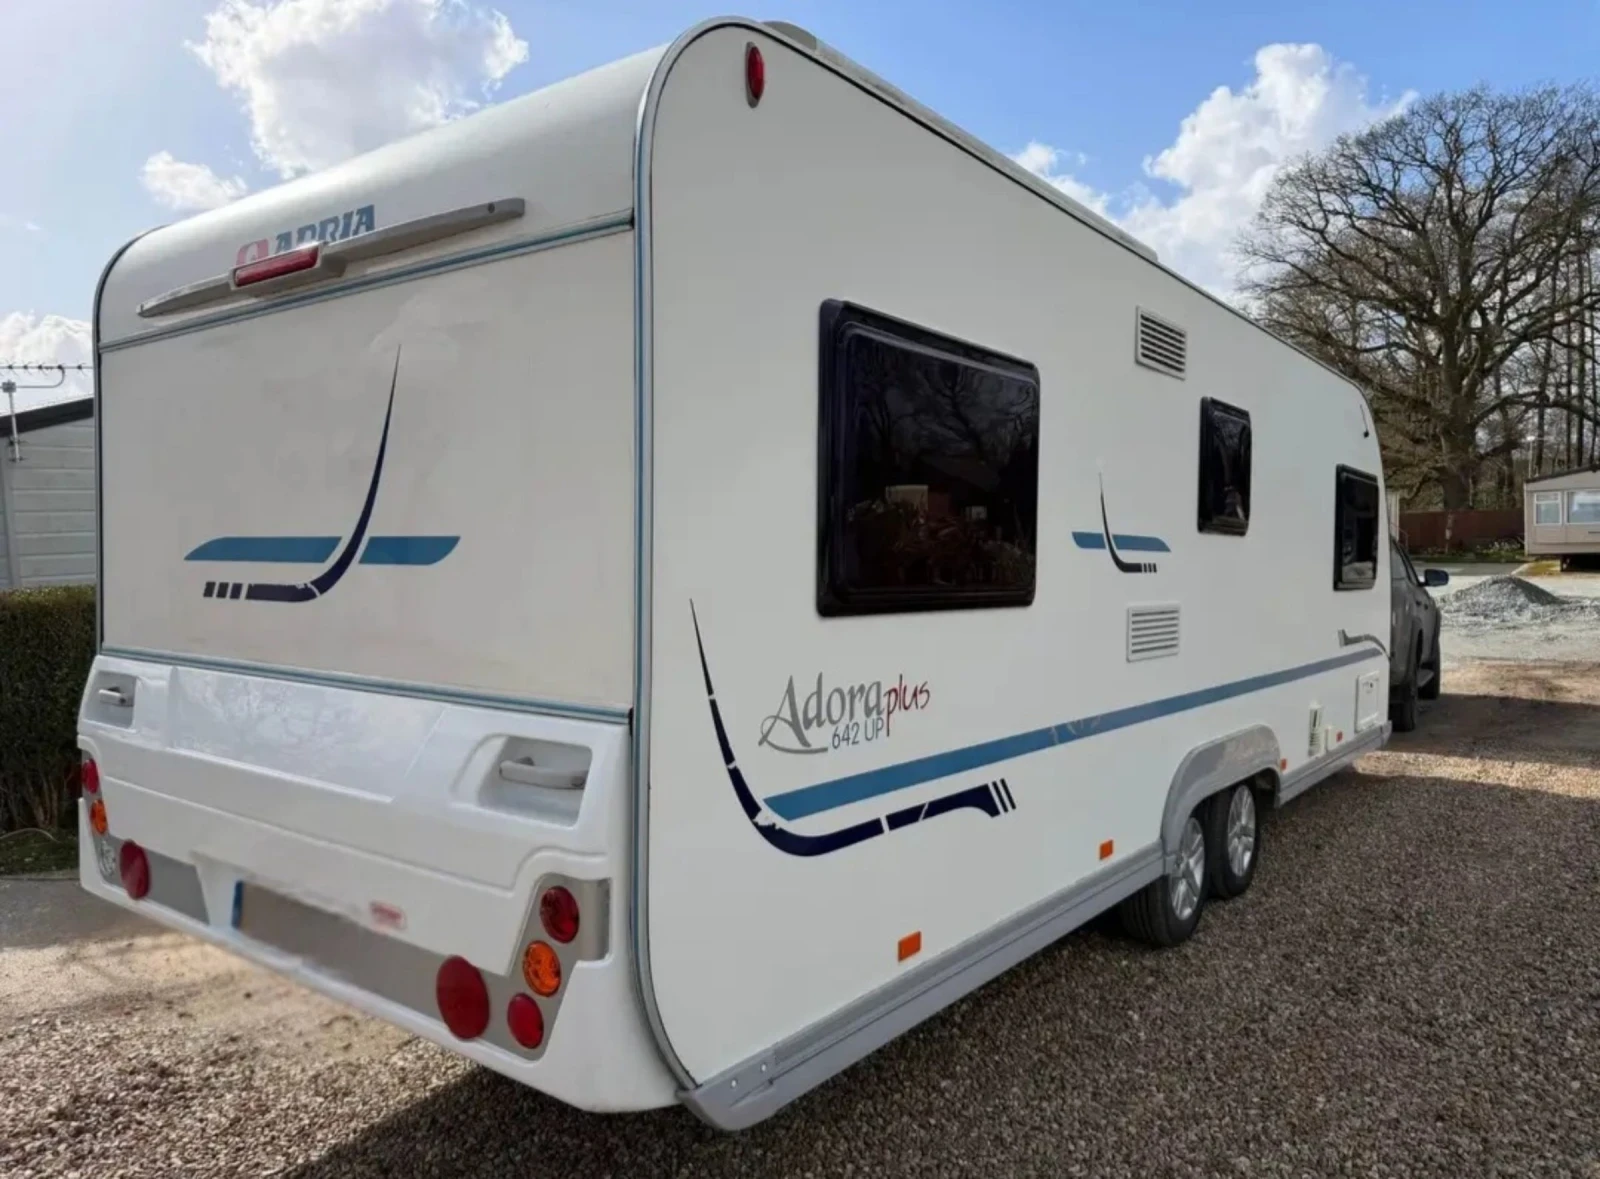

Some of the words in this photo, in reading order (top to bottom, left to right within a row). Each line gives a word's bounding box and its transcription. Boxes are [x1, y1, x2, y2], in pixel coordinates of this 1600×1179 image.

[275, 204, 375, 253] ADRIA
[758, 671, 884, 754] Adora
[883, 673, 931, 737] plus
[832, 722, 860, 749] 642
[864, 717, 884, 742] UP
